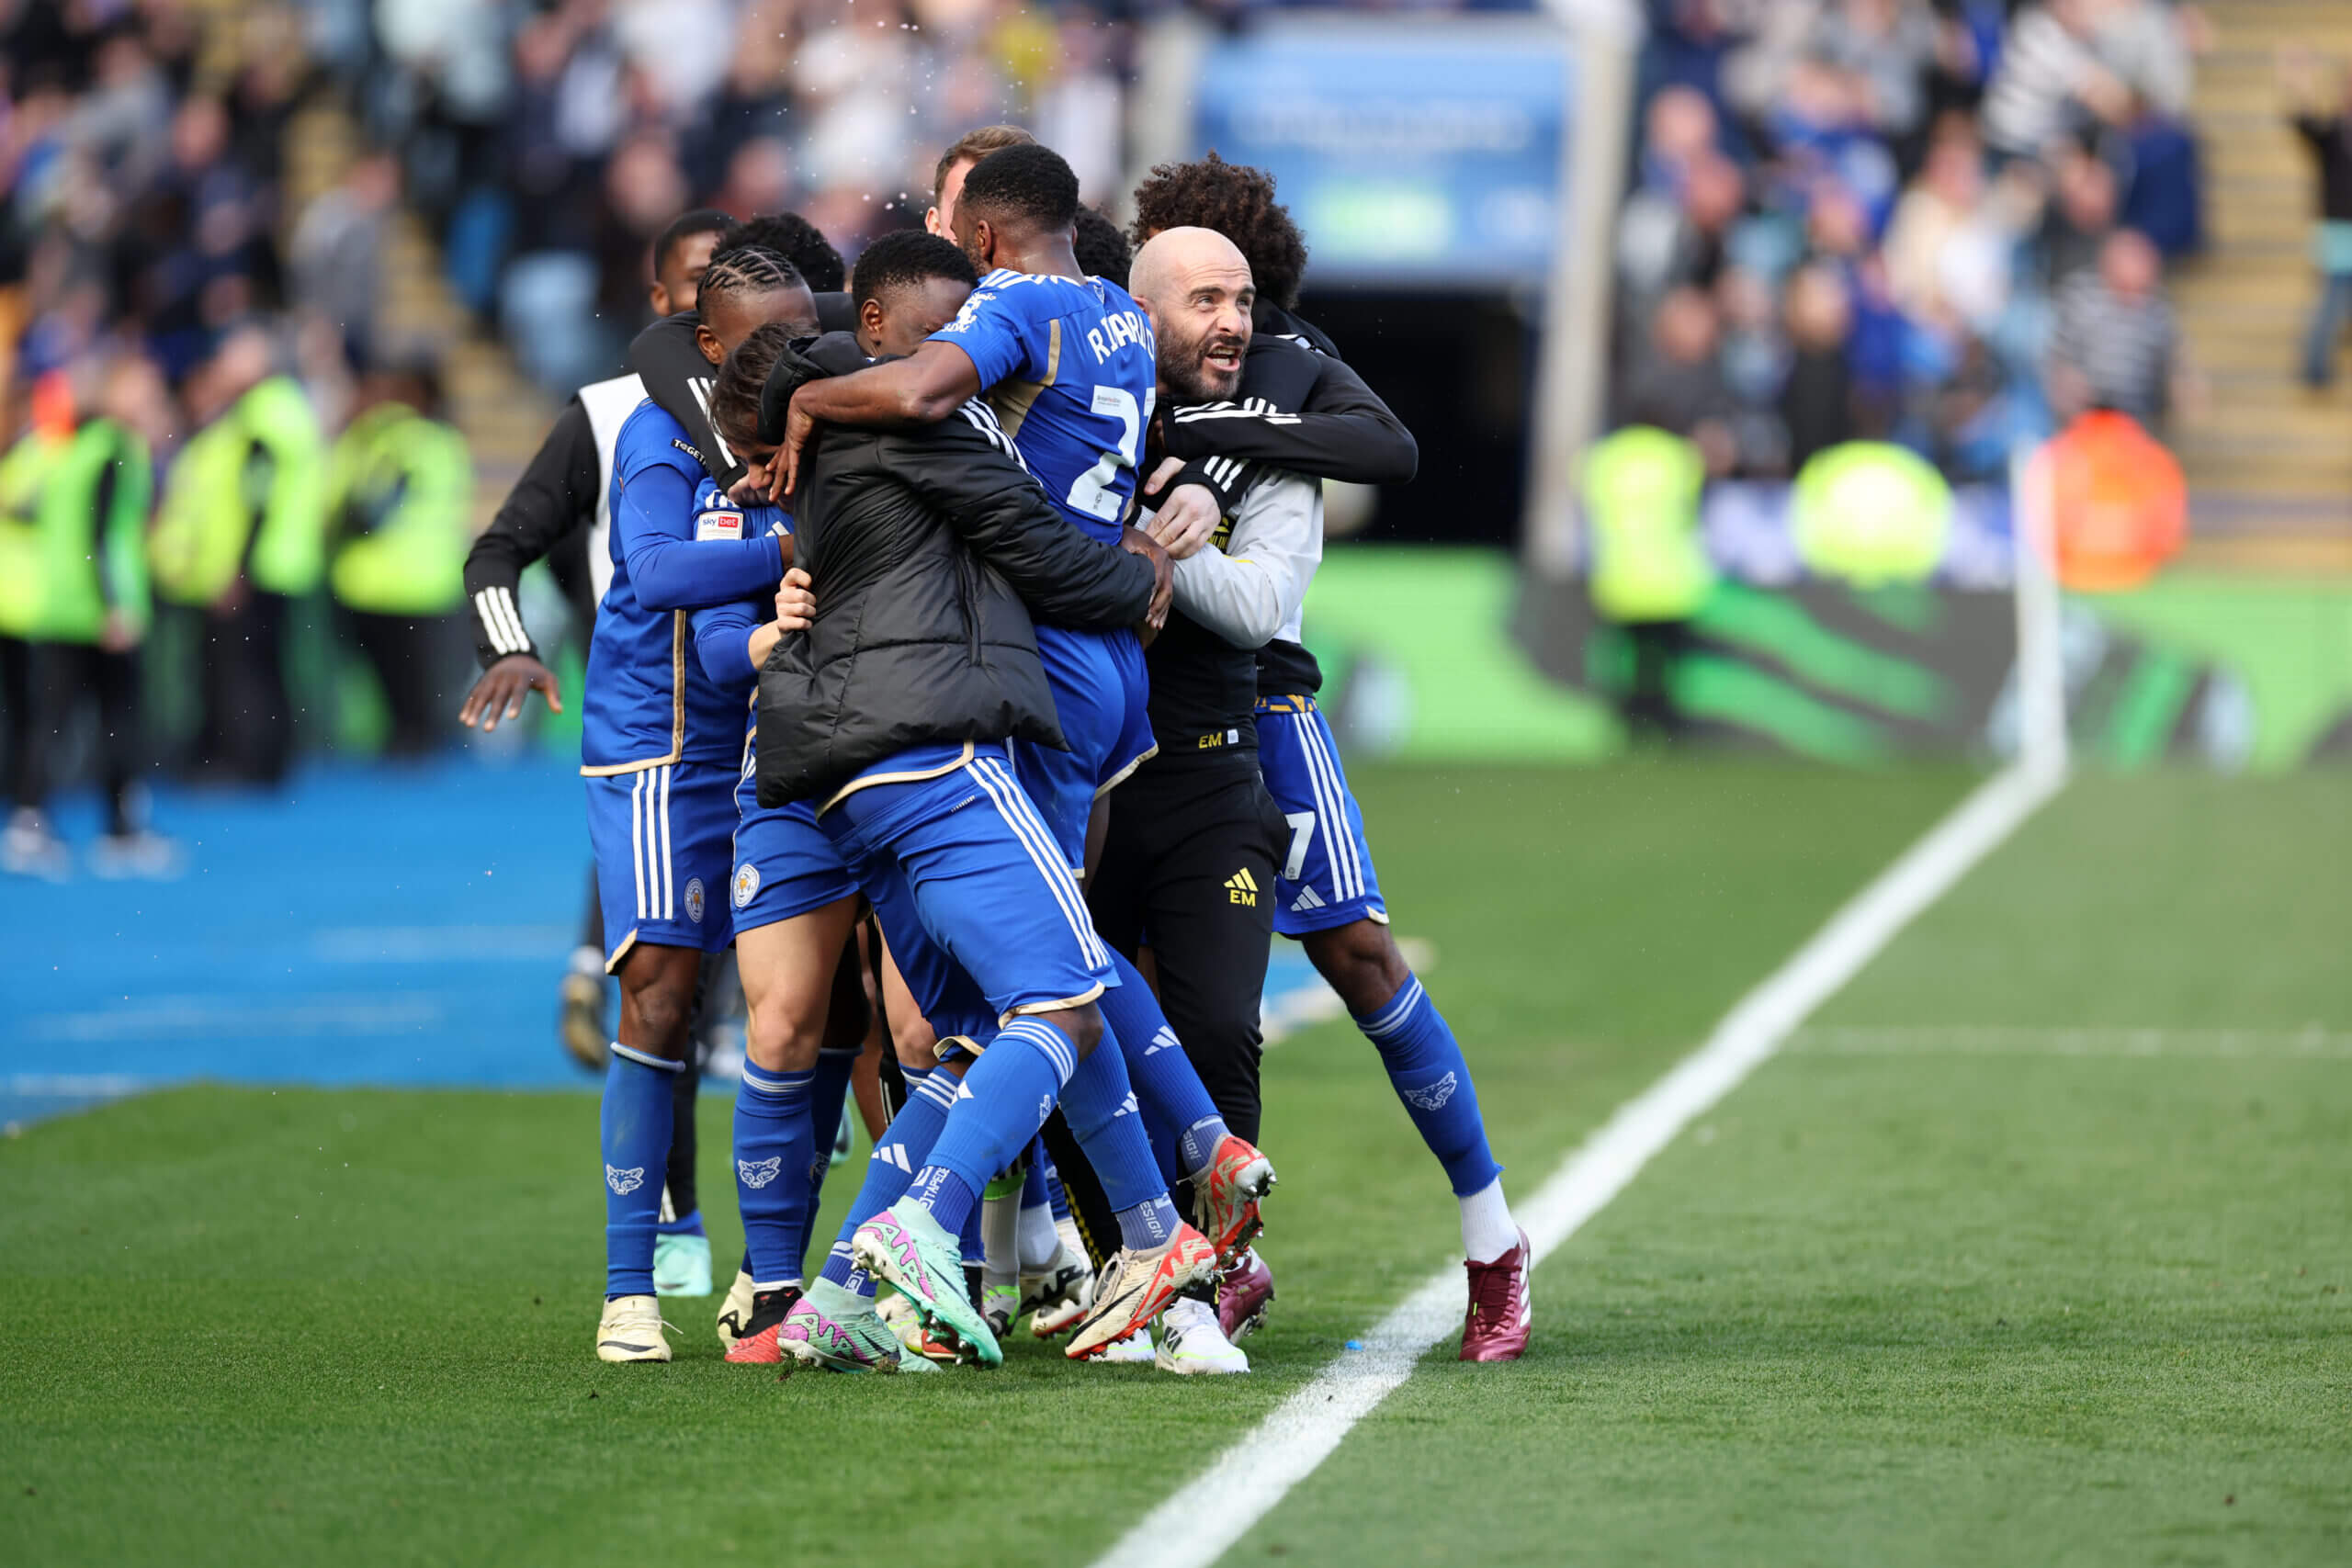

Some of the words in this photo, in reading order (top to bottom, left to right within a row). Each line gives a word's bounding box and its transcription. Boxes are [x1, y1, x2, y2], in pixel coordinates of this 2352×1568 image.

[702, 517, 717, 527] sky
[719, 517, 737, 526] bet
[1198, 731, 1223, 750] EM
[1284, 809, 1317, 881] 7
[1229, 888, 1257, 908] EM
